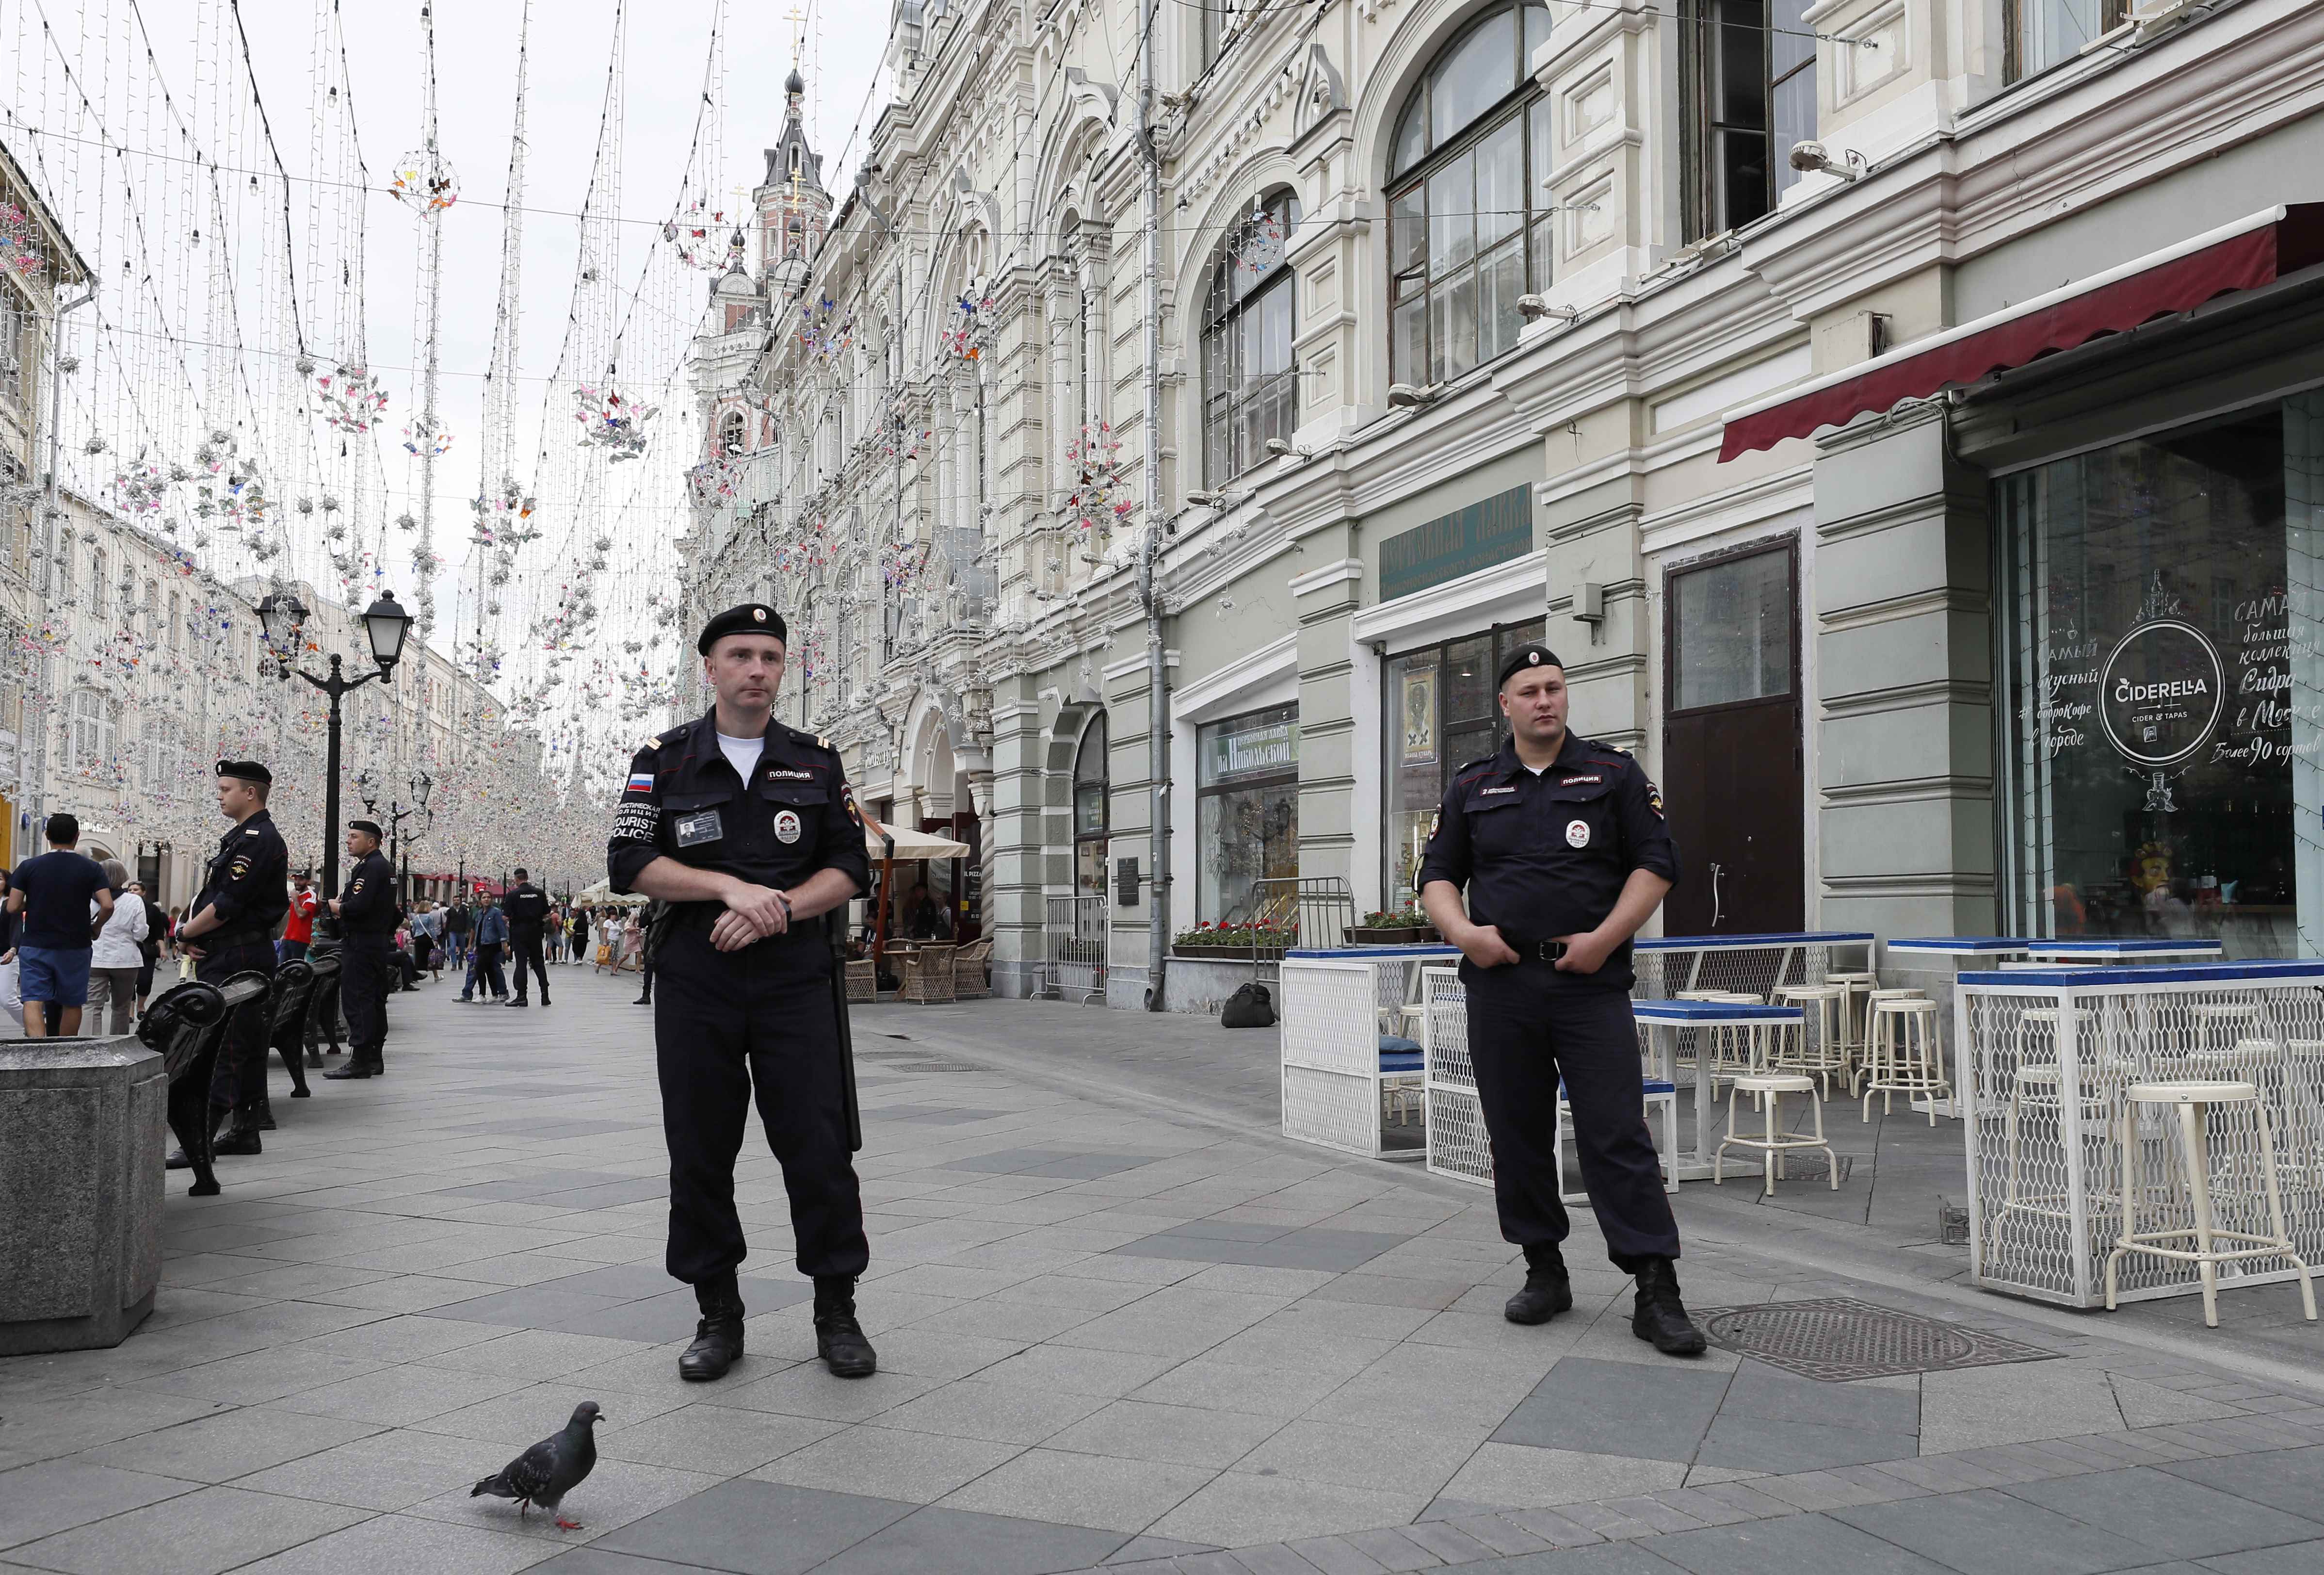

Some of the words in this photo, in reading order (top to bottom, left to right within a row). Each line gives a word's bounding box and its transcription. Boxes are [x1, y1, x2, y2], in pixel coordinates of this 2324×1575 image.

[2243, 622, 2305, 643] большая
[2037, 668, 2098, 698] вкусный
[2115, 678, 2207, 702] CIDERELLA
[1237, 731, 1268, 747] ЦЕРКОВНАЯ
[1269, 725, 1288, 739] ЛАВКА
[2045, 725, 2084, 758] городе
[2210, 742, 2249, 763] Более
[2247, 736, 2272, 767] 90
[2276, 734, 2321, 766] сортов
[1217, 754, 1228, 773] на
[769, 770, 810, 779] ПОЛИЦИЯ
[1563, 776, 1599, 784] ПОЛИЦИЯ
[618, 809, 658, 818] ОЛИЦИЯ
